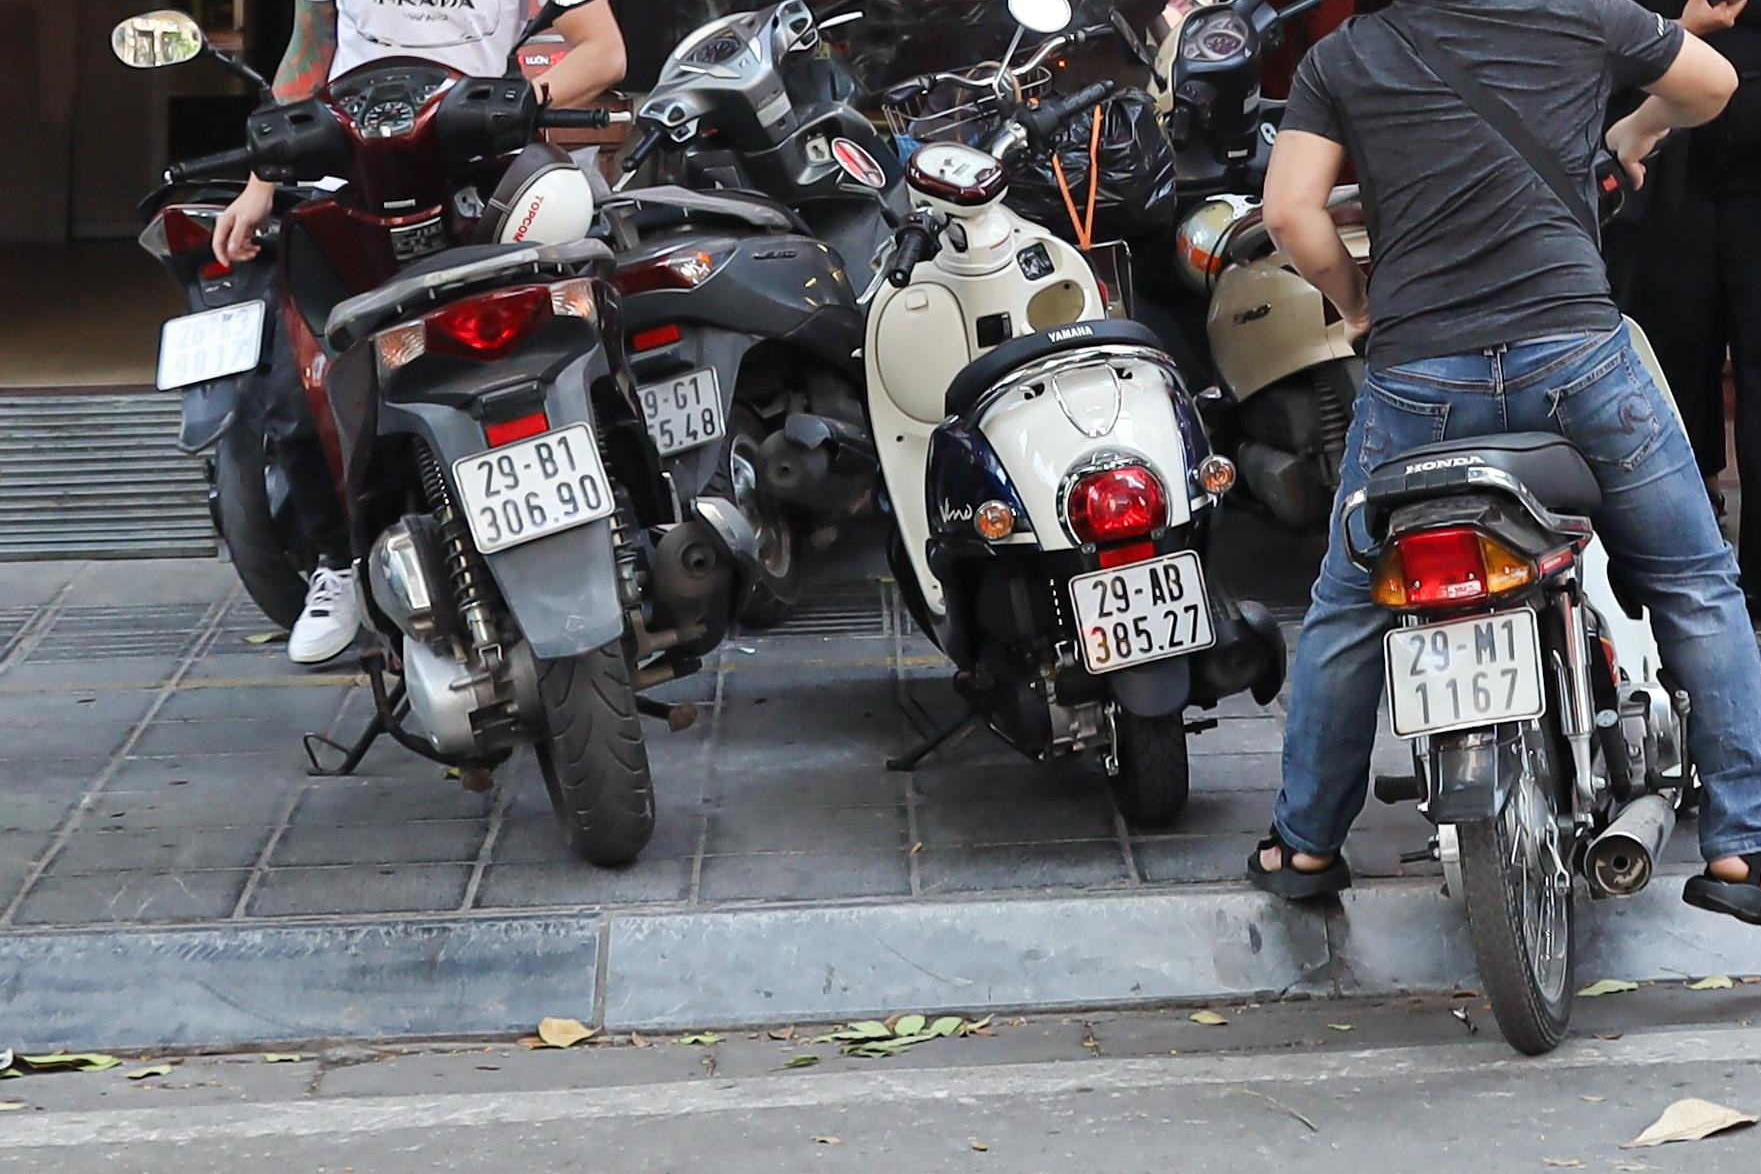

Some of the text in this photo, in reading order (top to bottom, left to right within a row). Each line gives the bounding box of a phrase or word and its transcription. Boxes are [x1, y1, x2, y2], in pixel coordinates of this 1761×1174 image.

[512, 194, 544, 243] TOPCOM
[1047, 325, 1095, 344] YAMAHA
[643, 376, 702, 420] 9-G1
[649, 407, 717, 451] 5.48
[477, 435, 577, 500] 29-B1
[1404, 454, 1486, 475] HONDA
[480, 473, 603, 544] 306.90
[1091, 563, 1185, 620] 29-AB
[1090, 605, 1200, 666] 385.27
[1409, 618, 1517, 678] 29-M1
[1414, 667, 1519, 725] 1167
